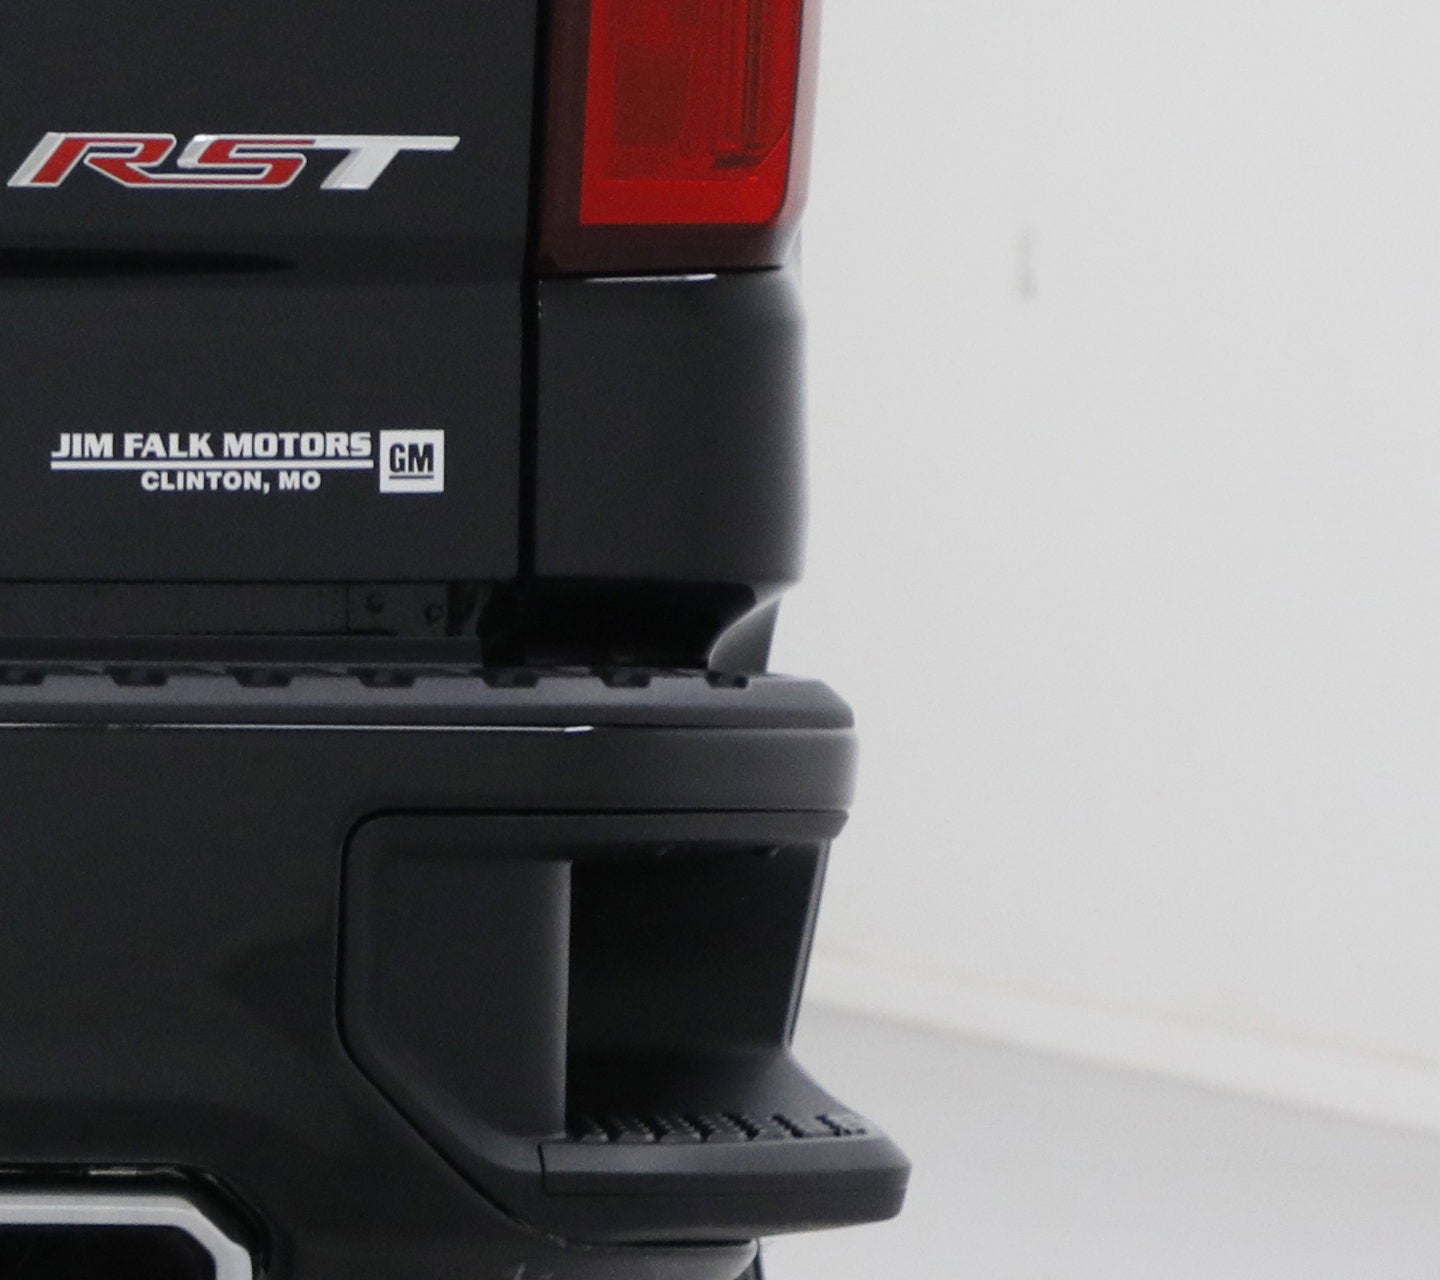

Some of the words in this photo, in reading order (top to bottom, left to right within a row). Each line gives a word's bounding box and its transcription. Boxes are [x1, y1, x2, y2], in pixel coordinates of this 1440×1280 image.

[7, 131, 460, 190] RST
[51, 432, 114, 459] JIM
[123, 432, 215, 459] FALK
[222, 431, 372, 458] MOTORS
[388, 442, 435, 474] GM
[140, 470, 271, 495] CLINTON,
[278, 470, 322, 491] MO
